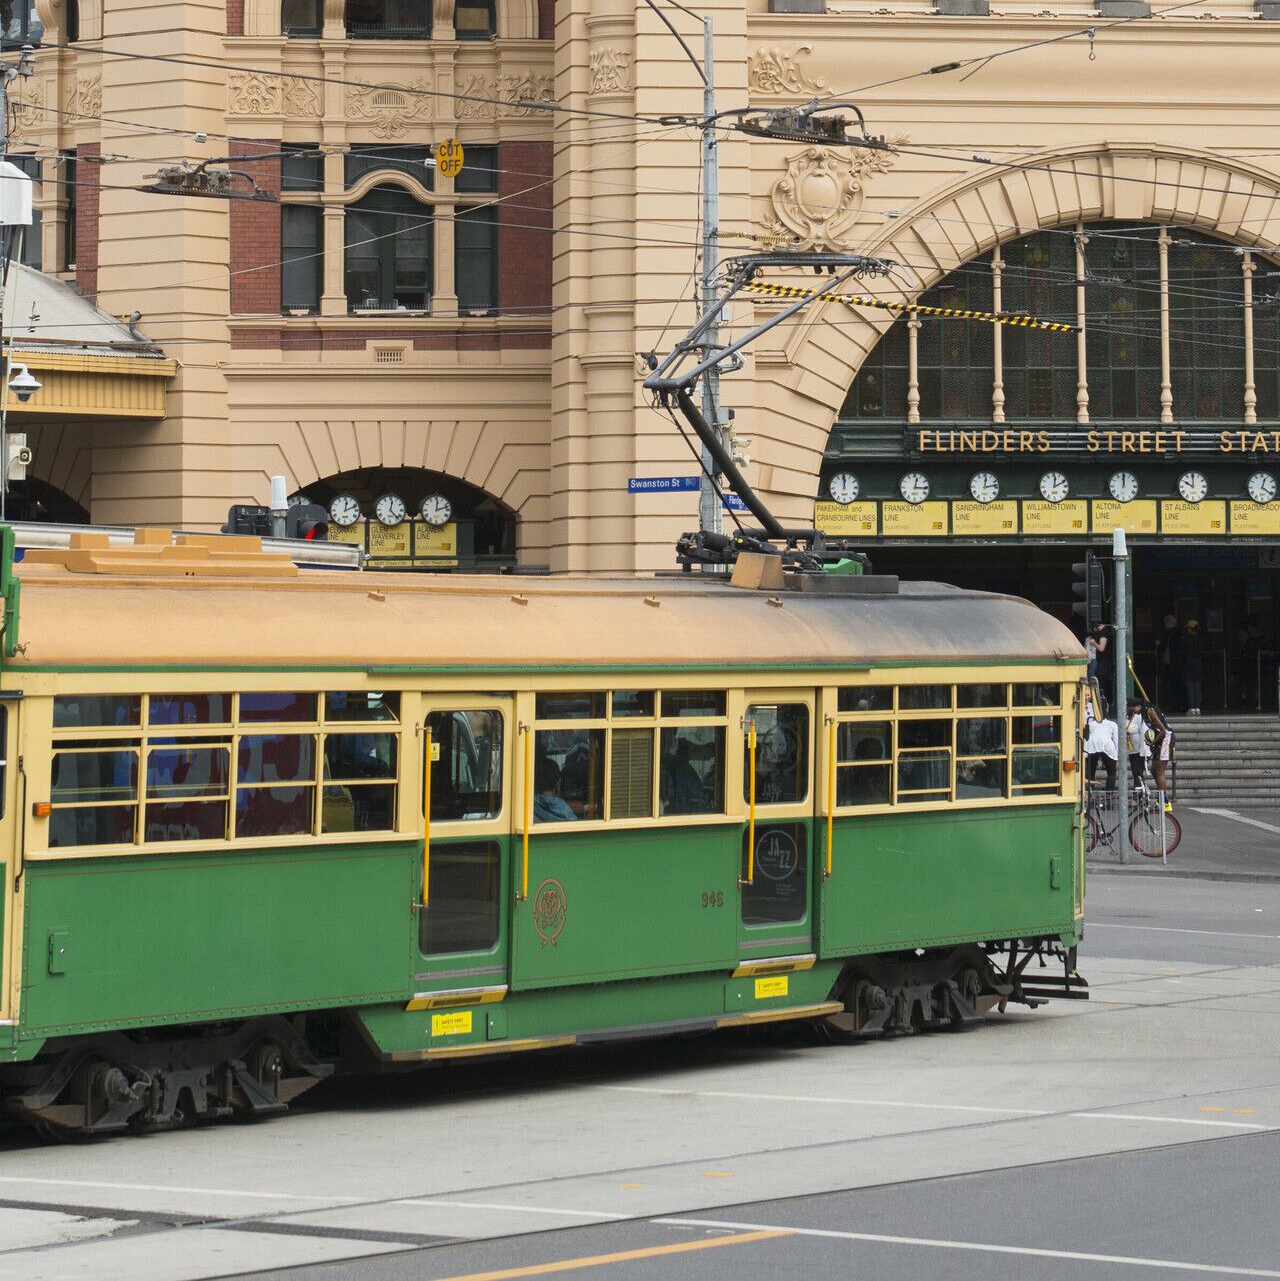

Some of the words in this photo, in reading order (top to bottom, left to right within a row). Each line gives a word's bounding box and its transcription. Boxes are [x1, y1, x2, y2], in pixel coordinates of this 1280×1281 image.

[439, 144, 460, 156] CUT
[440, 159, 461, 172] OFF
[919, 430, 1051, 453] FLINDERS
[1086, 430, 1186, 453] STREET
[630, 478, 670, 489] Swanston
[671, 478, 680, 487] St
[816, 504, 849, 512] PAKENHAM
[851, 504, 862, 512] and
[884, 504, 924, 512] FRANKSTON
[955, 504, 1004, 512] SANDRINGHAM
[1096, 502, 1122, 510] ALTONA
[816, 514, 858, 522] CRANBOURNE
[859, 514, 876, 522] LINES
[884, 514, 899, 522] LINE
[1096, 512, 1110, 520] LINE
[328, 526, 358, 534] ELGRAVE
[371, 526, 388, 534] GLEN
[417, 526, 445, 534] ALAMEIN
[701, 890, 724, 908] 946
